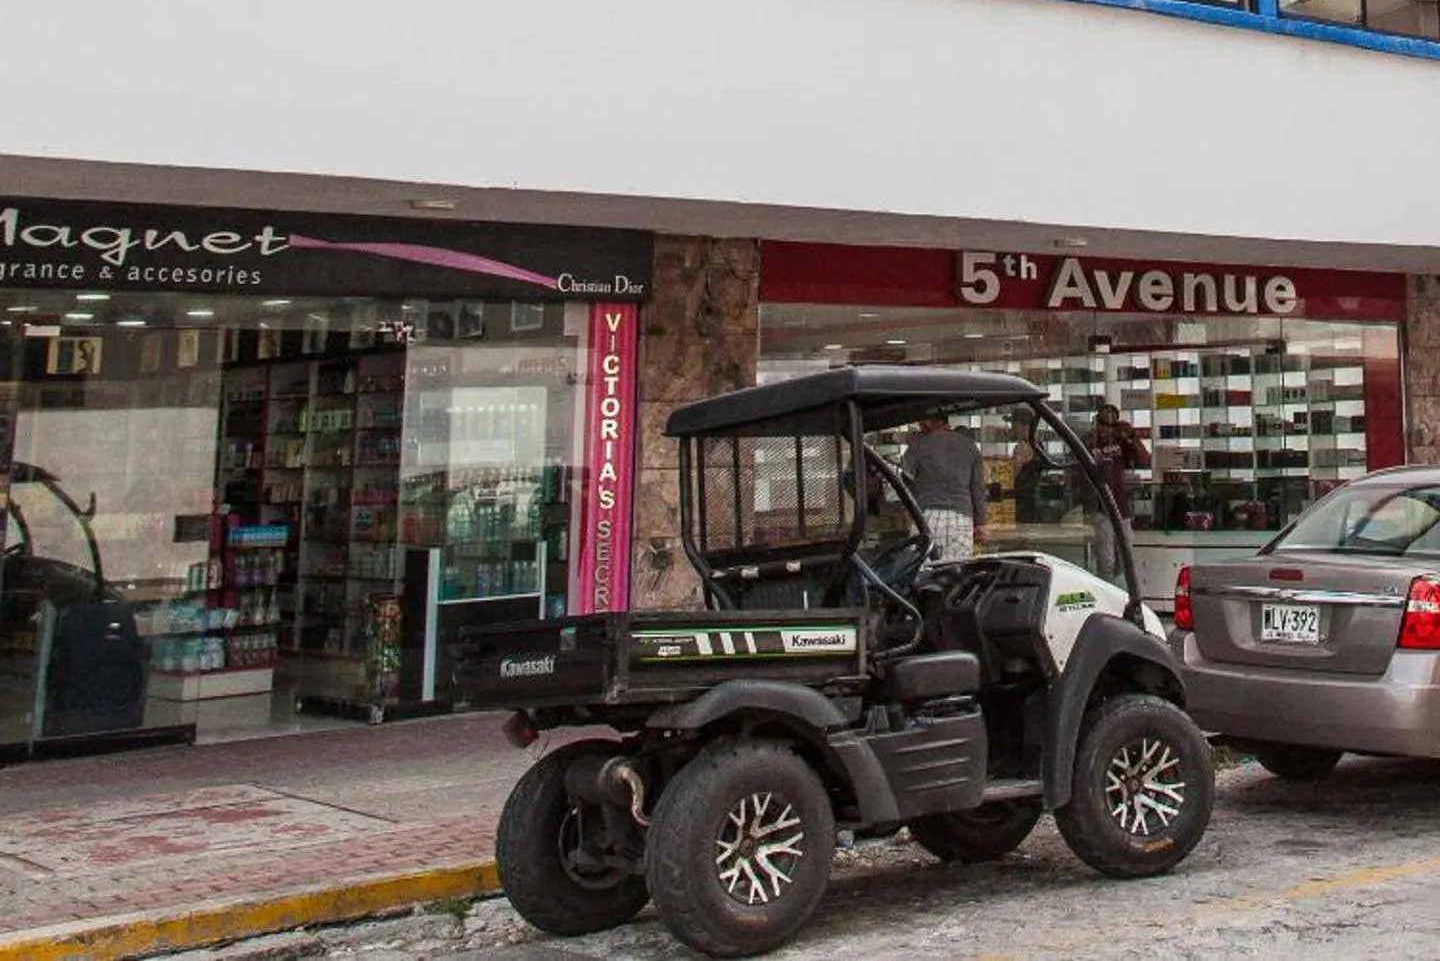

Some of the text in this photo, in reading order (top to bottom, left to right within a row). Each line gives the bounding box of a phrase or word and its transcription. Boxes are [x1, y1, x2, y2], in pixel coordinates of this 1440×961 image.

[99, 264, 113, 279] &
[128, 264, 262, 285] accesories
[558, 272, 644, 294] Christian Dior
[959, 251, 1299, 314] 5th Avenue
[599, 313, 622, 510] VICTORIA'S
[791, 633, 847, 648] Kawasaki
[500, 655, 556, 678] Kawasaki
